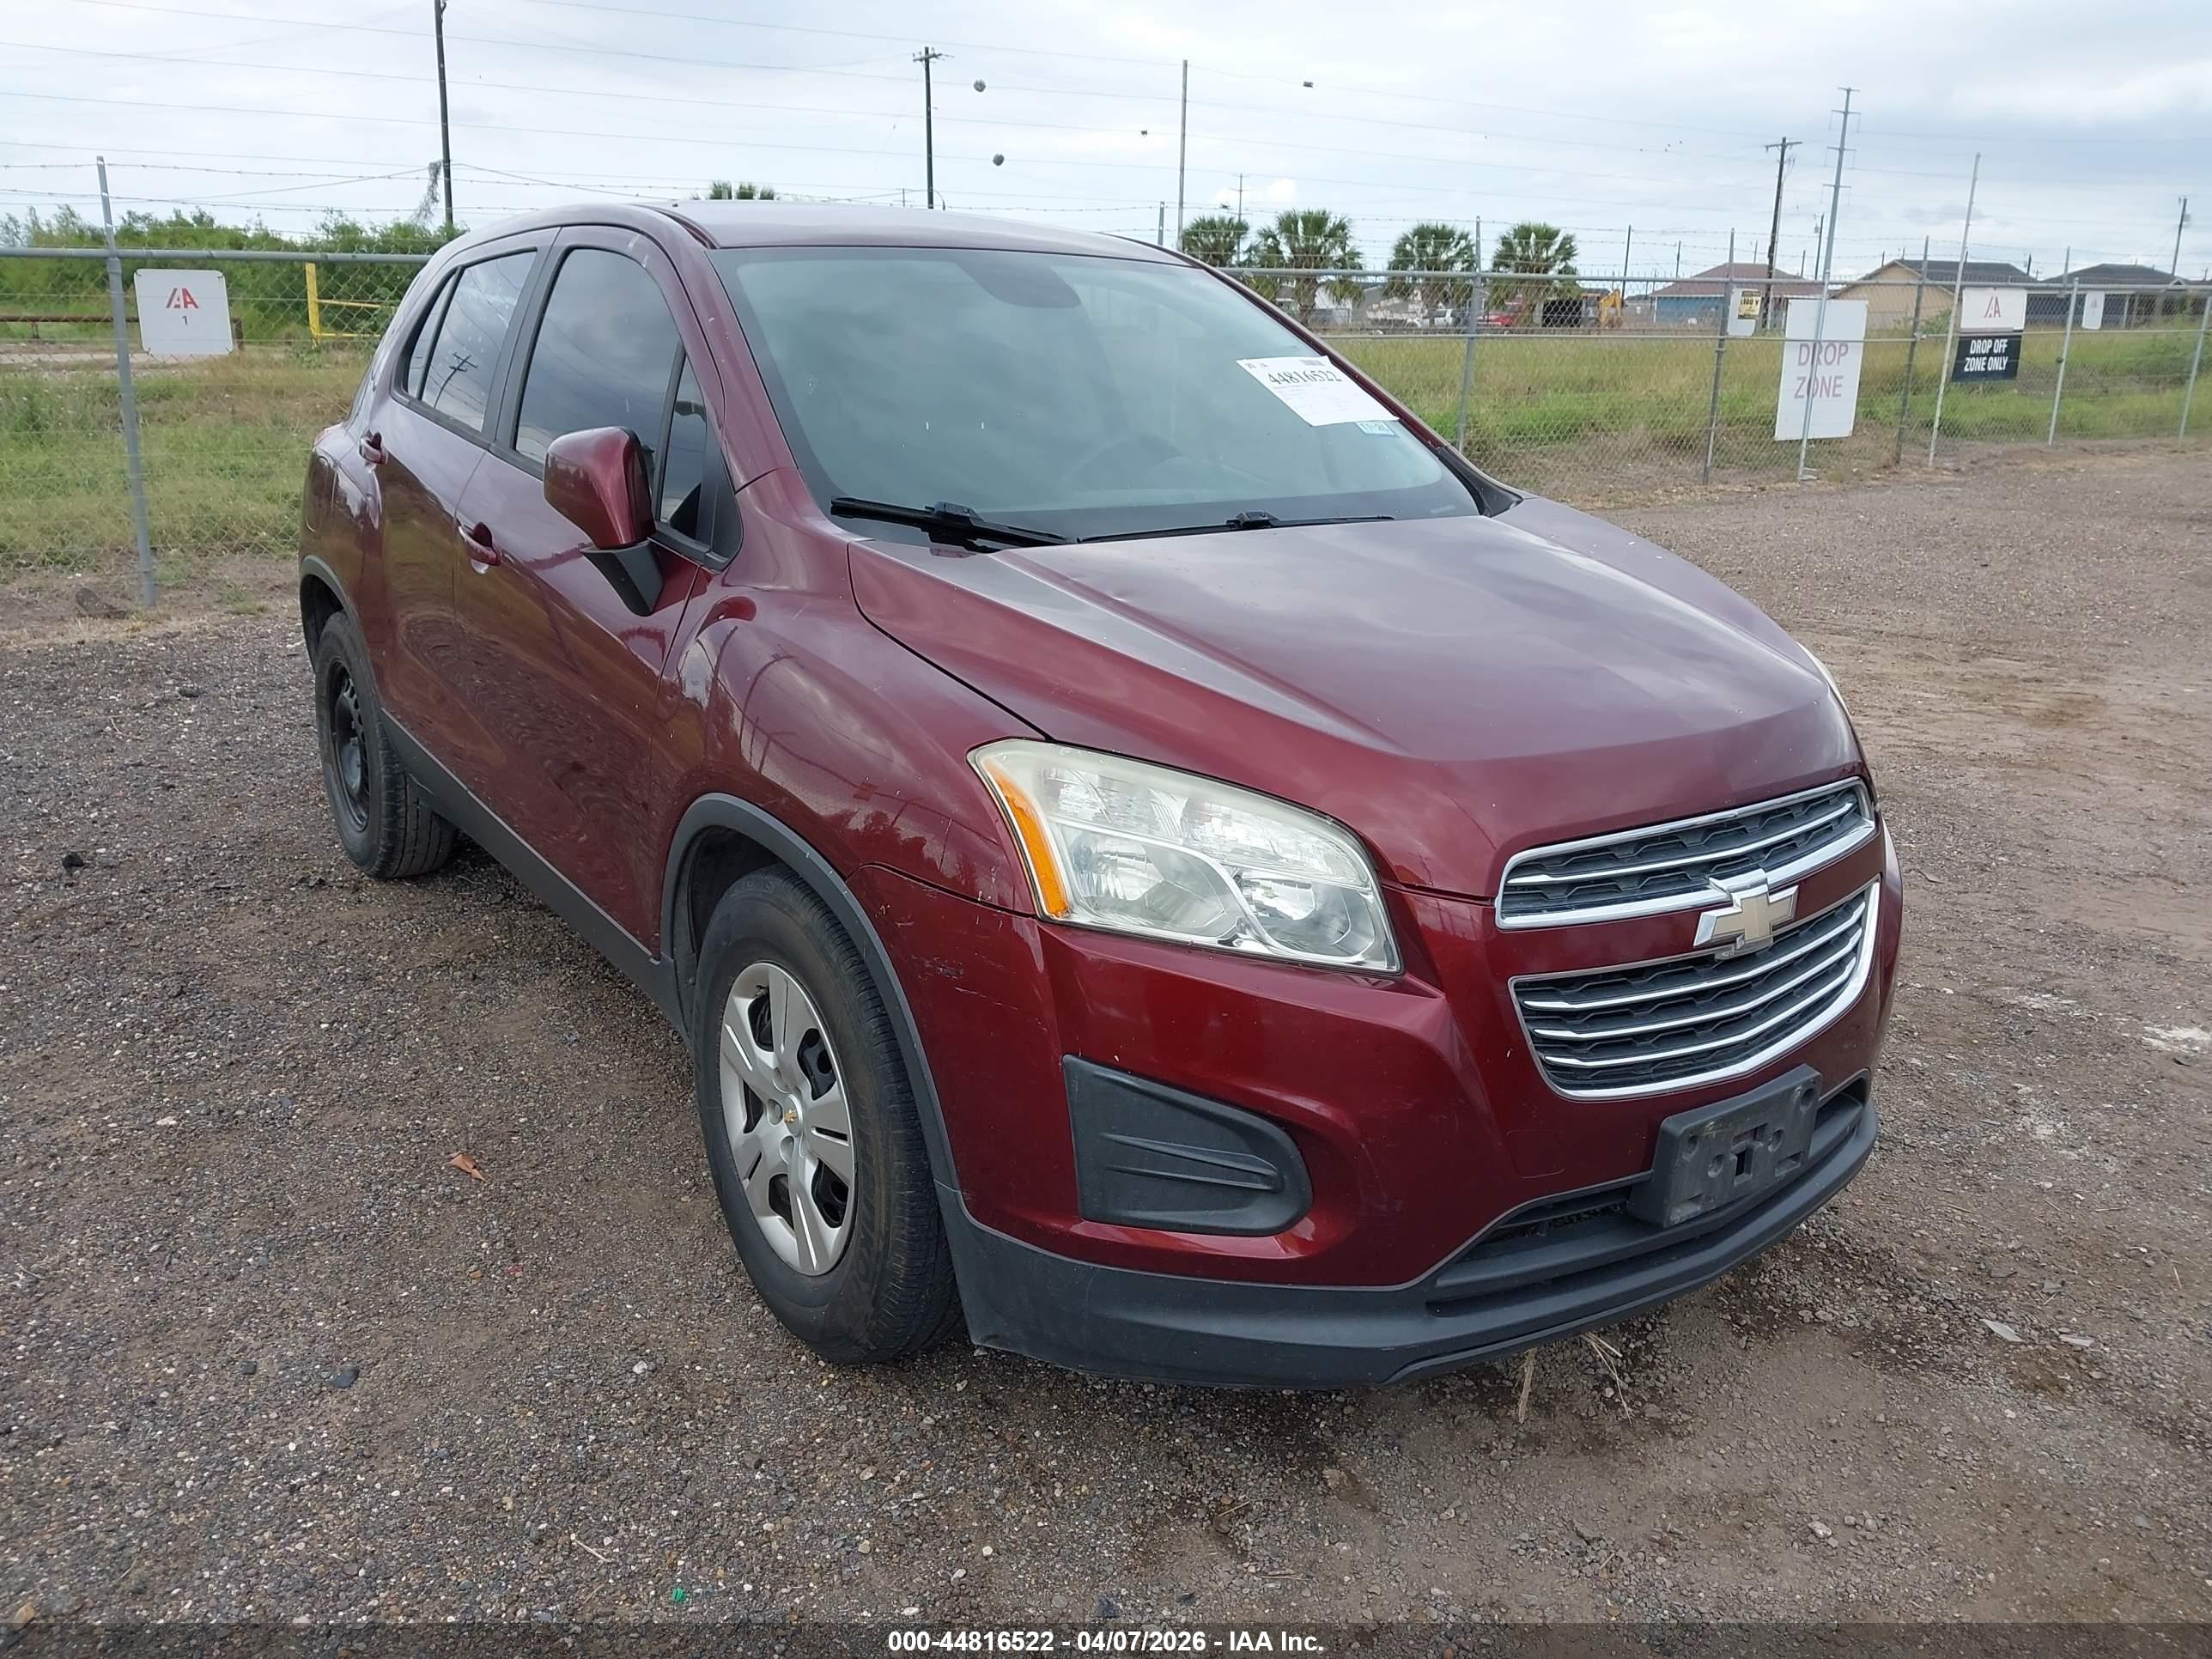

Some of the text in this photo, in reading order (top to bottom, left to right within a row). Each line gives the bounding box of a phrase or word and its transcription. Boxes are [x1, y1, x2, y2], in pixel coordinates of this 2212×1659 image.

[1797, 342, 1849, 367] DROP
[1970, 338, 2008, 355] DROP OFF
[1964, 356, 2008, 372] ZONE ONLY
[1267, 370, 1342, 385] 44816522
[1794, 374, 1844, 399] ZONE
